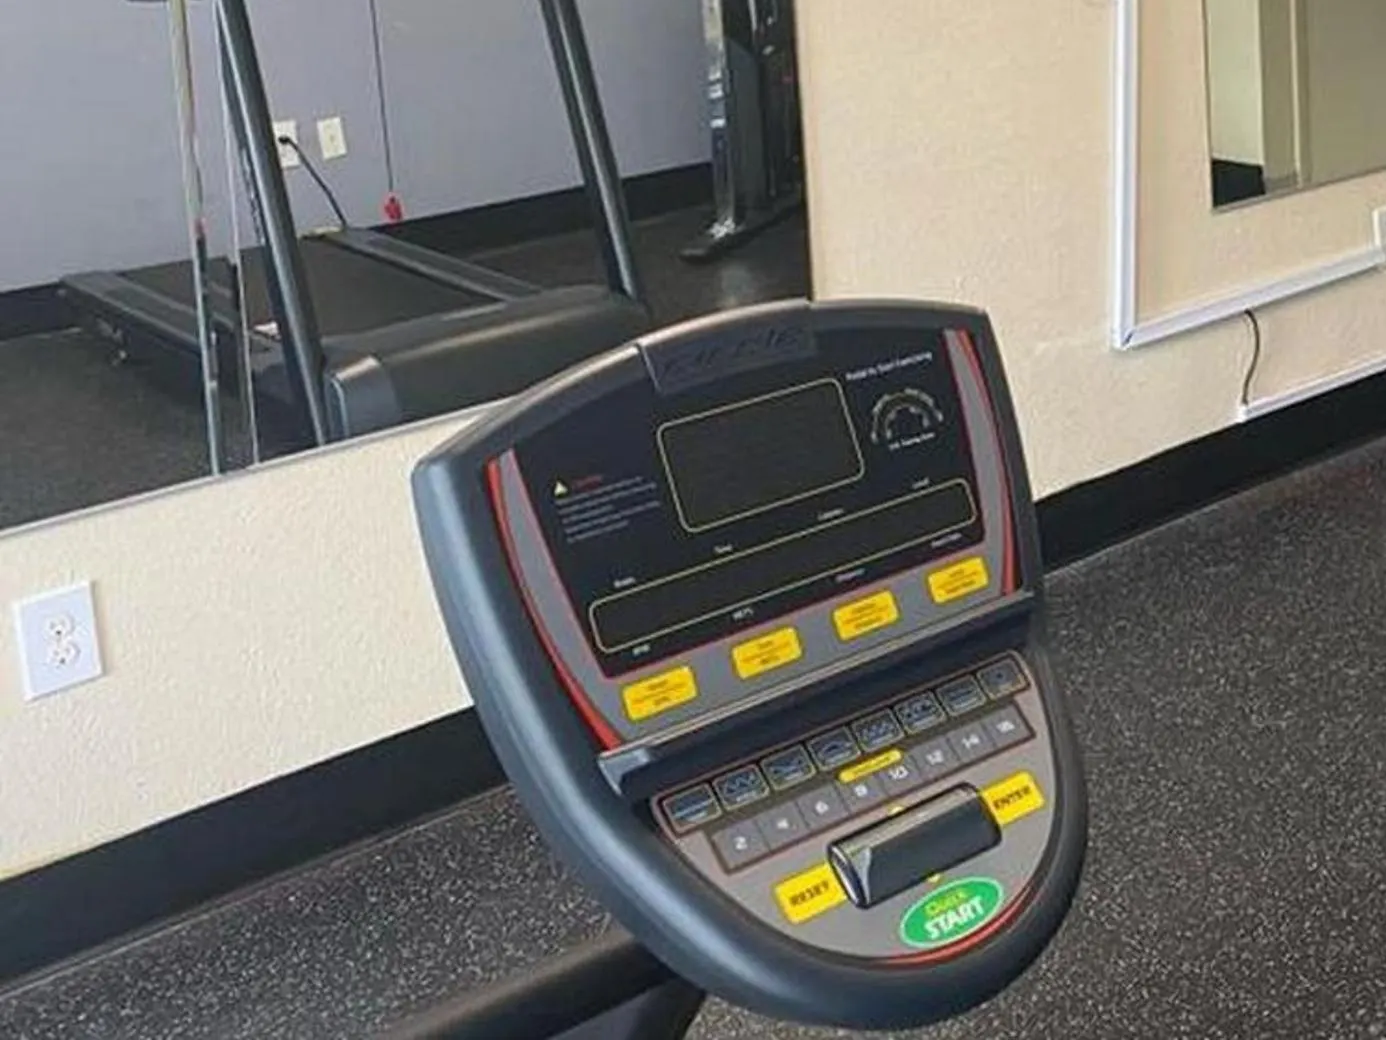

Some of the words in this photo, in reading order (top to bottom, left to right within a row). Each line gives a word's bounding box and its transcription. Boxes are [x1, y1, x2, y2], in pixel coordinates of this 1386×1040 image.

[733, 836, 748, 851] 2
[887, 765, 909, 782] 10
[992, 785, 1033, 811] ENTER
[789, 879, 831, 909] RESET
[923, 896, 986, 941] START
